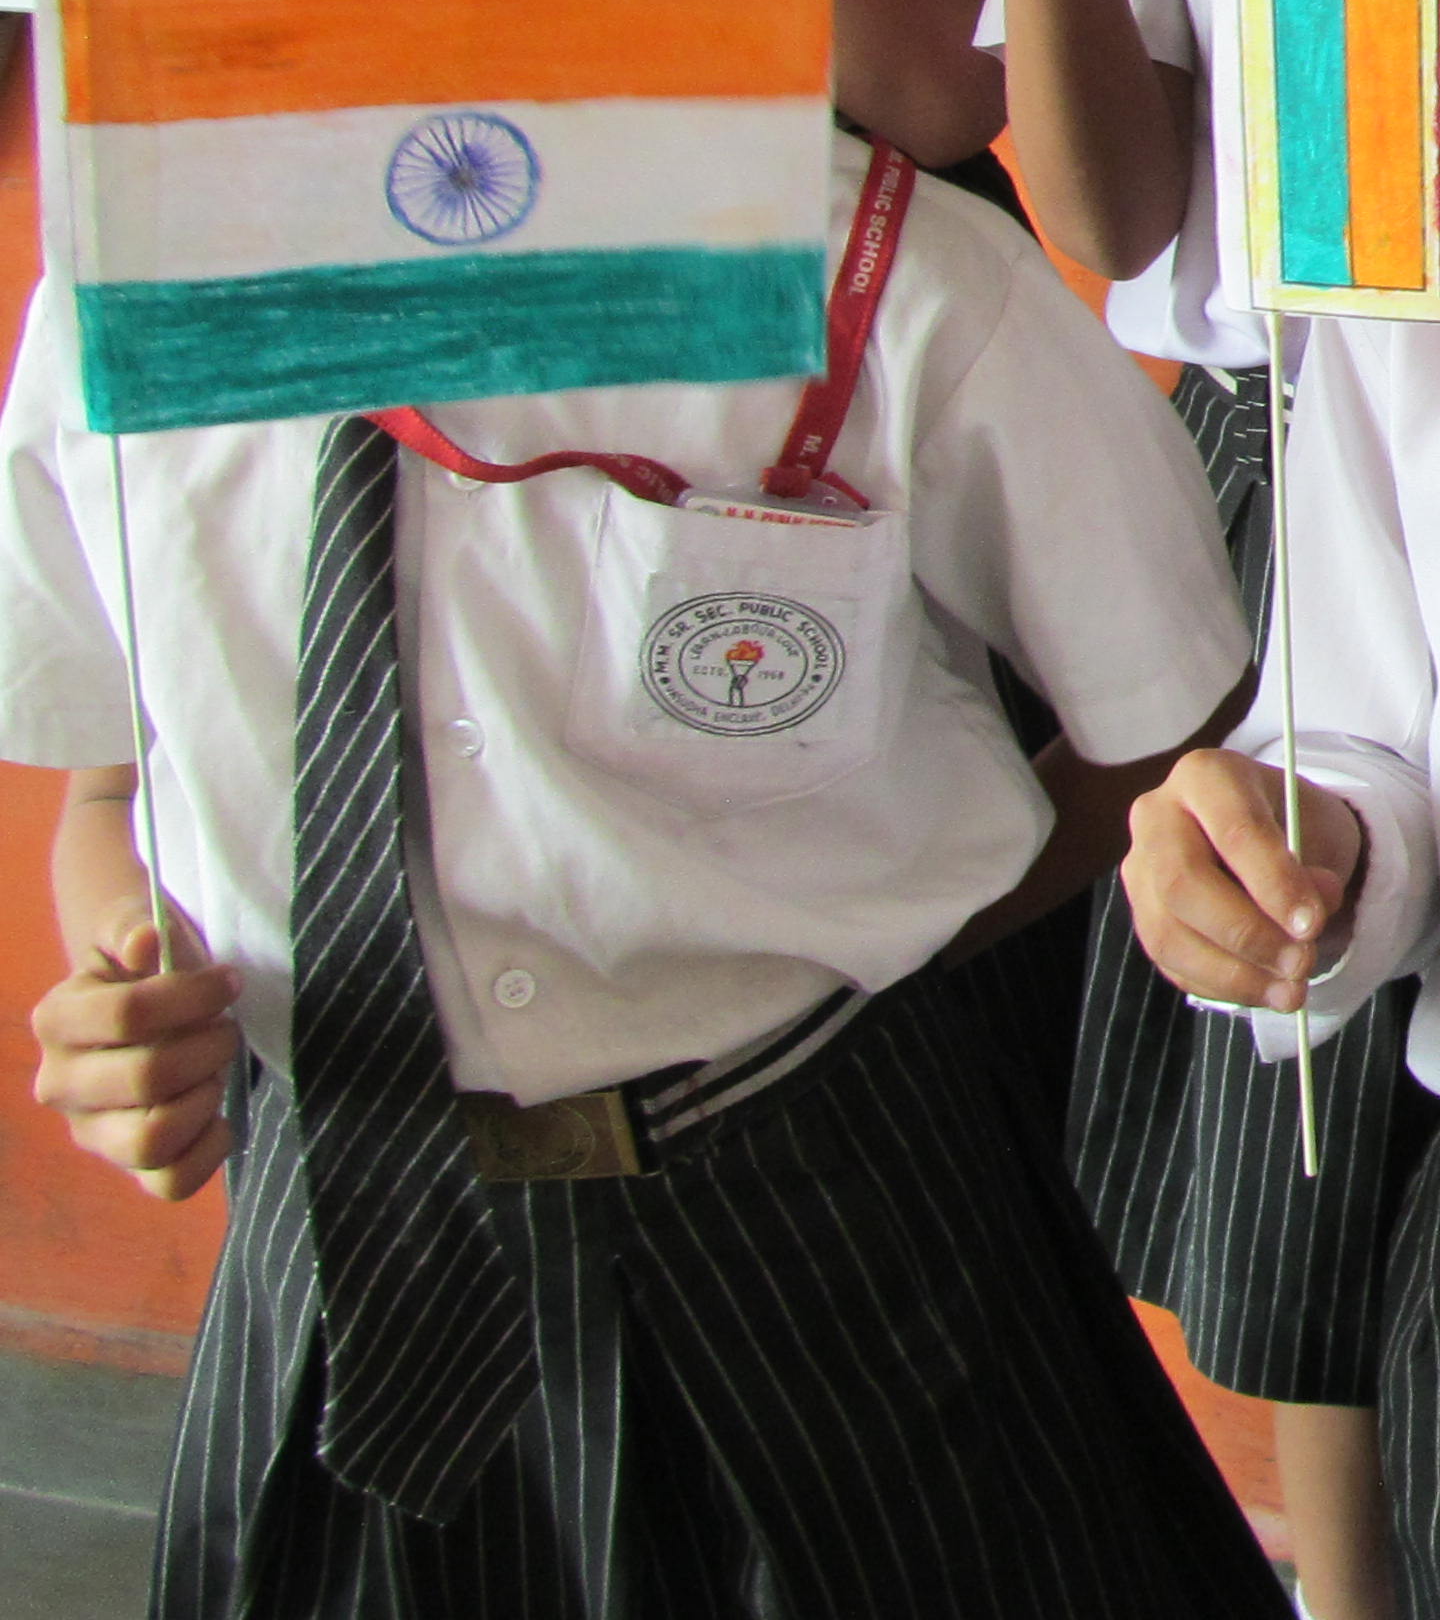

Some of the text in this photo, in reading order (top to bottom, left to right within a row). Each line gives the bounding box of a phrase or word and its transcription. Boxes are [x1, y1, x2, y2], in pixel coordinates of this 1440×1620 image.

[848, 214, 888, 295] SCHOOL
[738, 601, 794, 623] PUBLIC
[797, 620, 828, 669] SCHOOL
